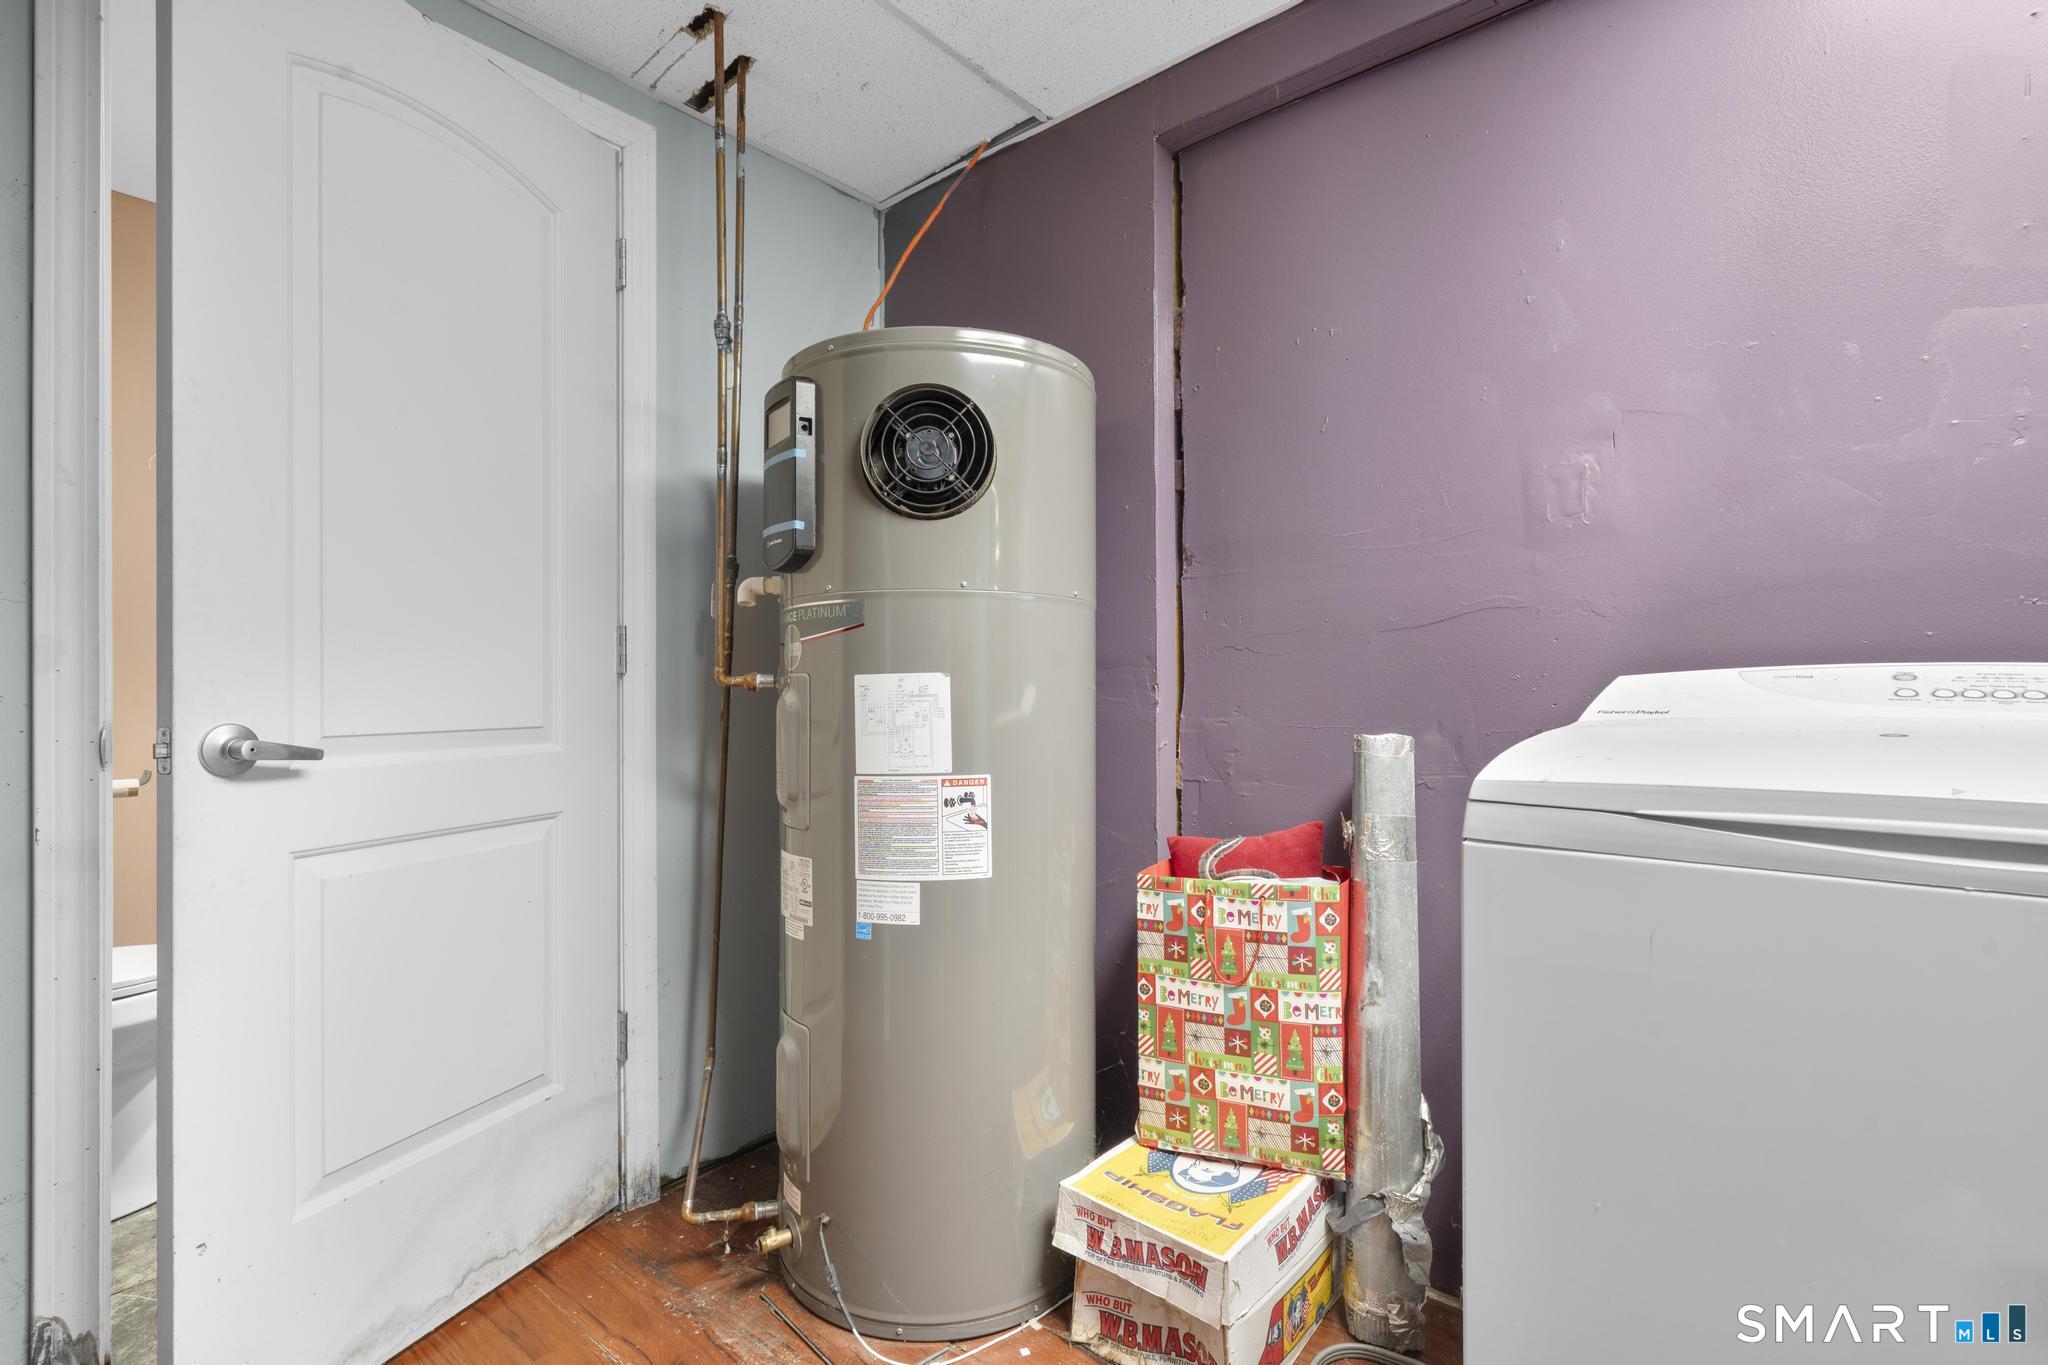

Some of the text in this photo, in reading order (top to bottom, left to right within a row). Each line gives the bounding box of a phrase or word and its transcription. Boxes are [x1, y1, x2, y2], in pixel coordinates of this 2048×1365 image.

[1218, 907, 1235, 925] Be
[1160, 986, 1176, 1002] Be
[1283, 1001, 1302, 1020] Be
[1220, 1081, 1238, 1098] Be
[1103, 1170, 1244, 1231] FLAGSHIP
[1076, 1206, 1114, 1229] WHO BUT
[1266, 1216, 1290, 1246] WHO BUT
[1085, 1250, 1096, 1258] FOR
[1096, 1255, 1115, 1267] OFFICE
[1142, 1267, 1173, 1280] FURNITURE
[1179, 1279, 1205, 1298] PRINTING
[1085, 1294, 1133, 1315] WHO BUT
[1110, 1342, 1130, 1355] OFFICE
